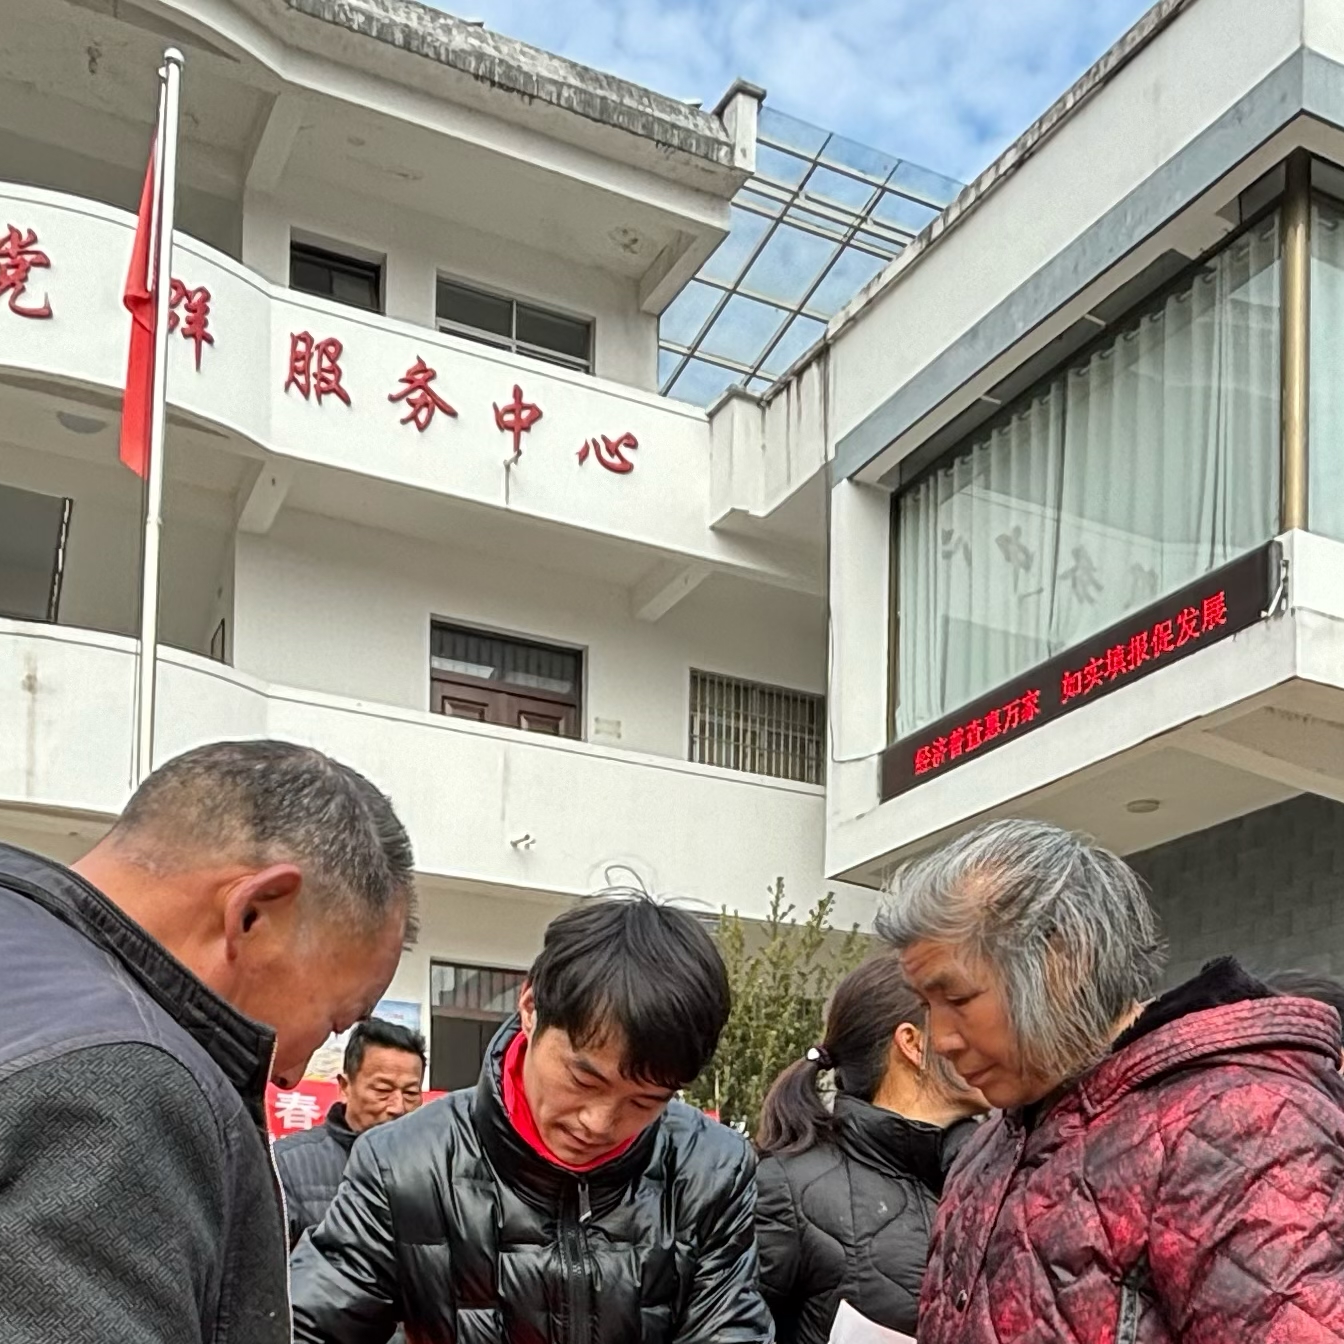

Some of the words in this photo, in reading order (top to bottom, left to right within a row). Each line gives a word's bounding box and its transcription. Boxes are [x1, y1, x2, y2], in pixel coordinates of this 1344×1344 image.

[914, 689, 1041, 775] 经济普查惠万家
[1061, 590, 1227, 704] 如实填报促发展
[274, 1091, 321, 1130] 春
